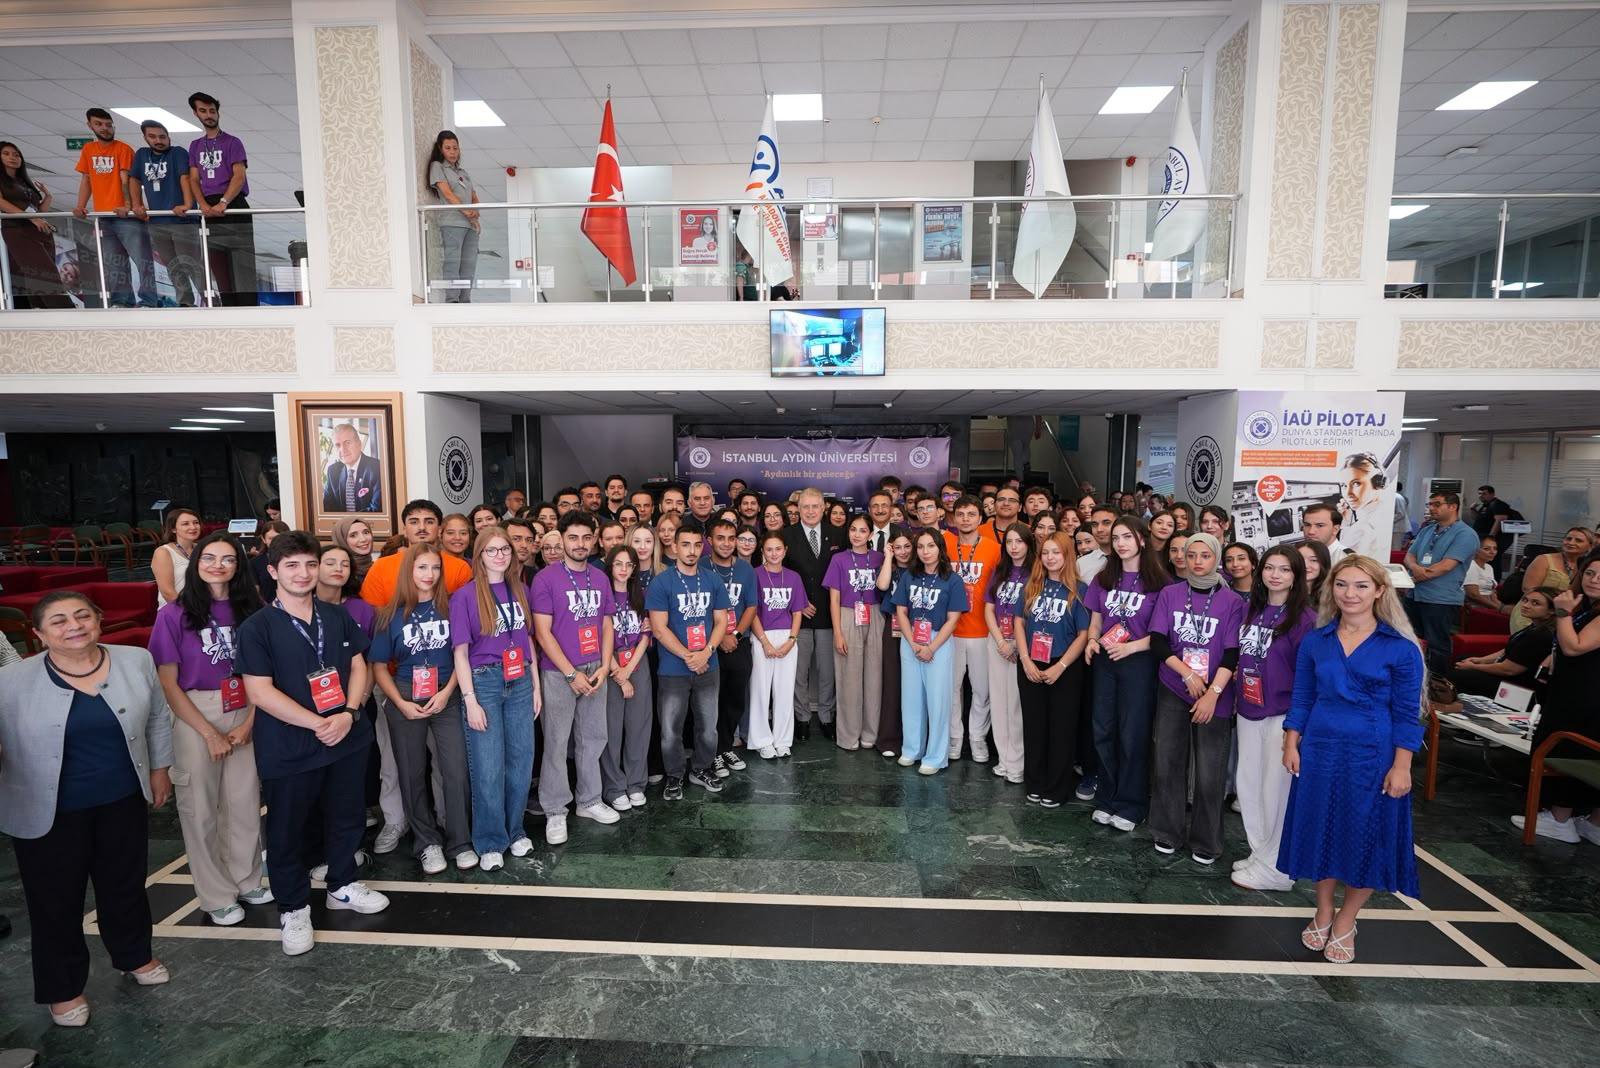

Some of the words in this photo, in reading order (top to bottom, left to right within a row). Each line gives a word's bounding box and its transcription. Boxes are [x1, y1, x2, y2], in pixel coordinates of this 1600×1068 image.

[758, 194, 783, 229] AADOLU
[1283, 410, 1313, 426] İAÜ
[1317, 410, 1387, 427] PİLOTAJ
[1314, 428, 1395, 437] STANDARTLARINDA
[722, 451, 778, 463] İSTANBUL
[781, 453, 816, 463] AYDIN
[819, 451, 897, 463] ÜNİVERSİTESİ
[803, 470, 816, 478] bir
[762, 587, 792, 603] IAU
[495, 602, 525, 624] AU
[1106, 602, 1137, 618] Tem
[1173, 611, 1219, 639] IAU
[200, 626, 236, 651] IA
[205, 643, 236, 664] Tea
